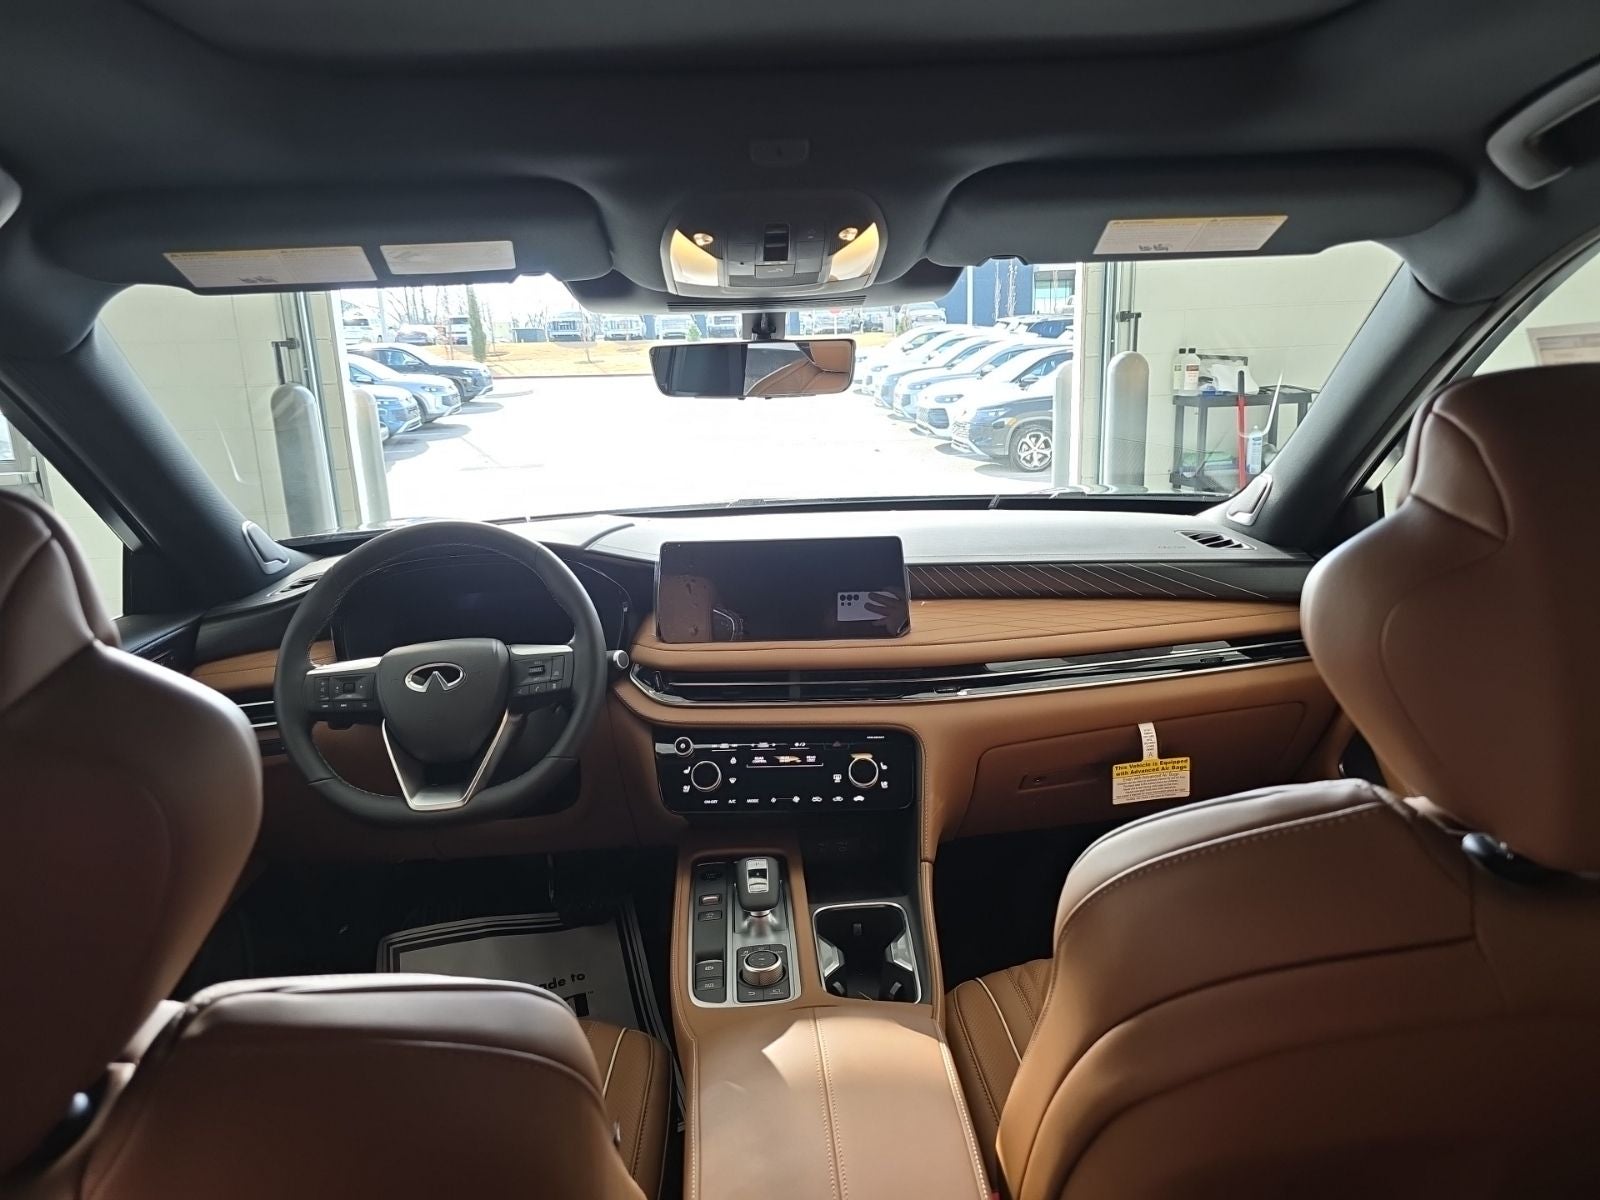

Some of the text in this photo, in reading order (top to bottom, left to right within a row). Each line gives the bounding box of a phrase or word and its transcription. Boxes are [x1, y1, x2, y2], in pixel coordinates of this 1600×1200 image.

[1160, 758, 1188, 767] Equipped
[1130, 767, 1160, 775] Advanced
[1171, 764, 1188, 772] Bags
[570, 973, 586, 983] to
